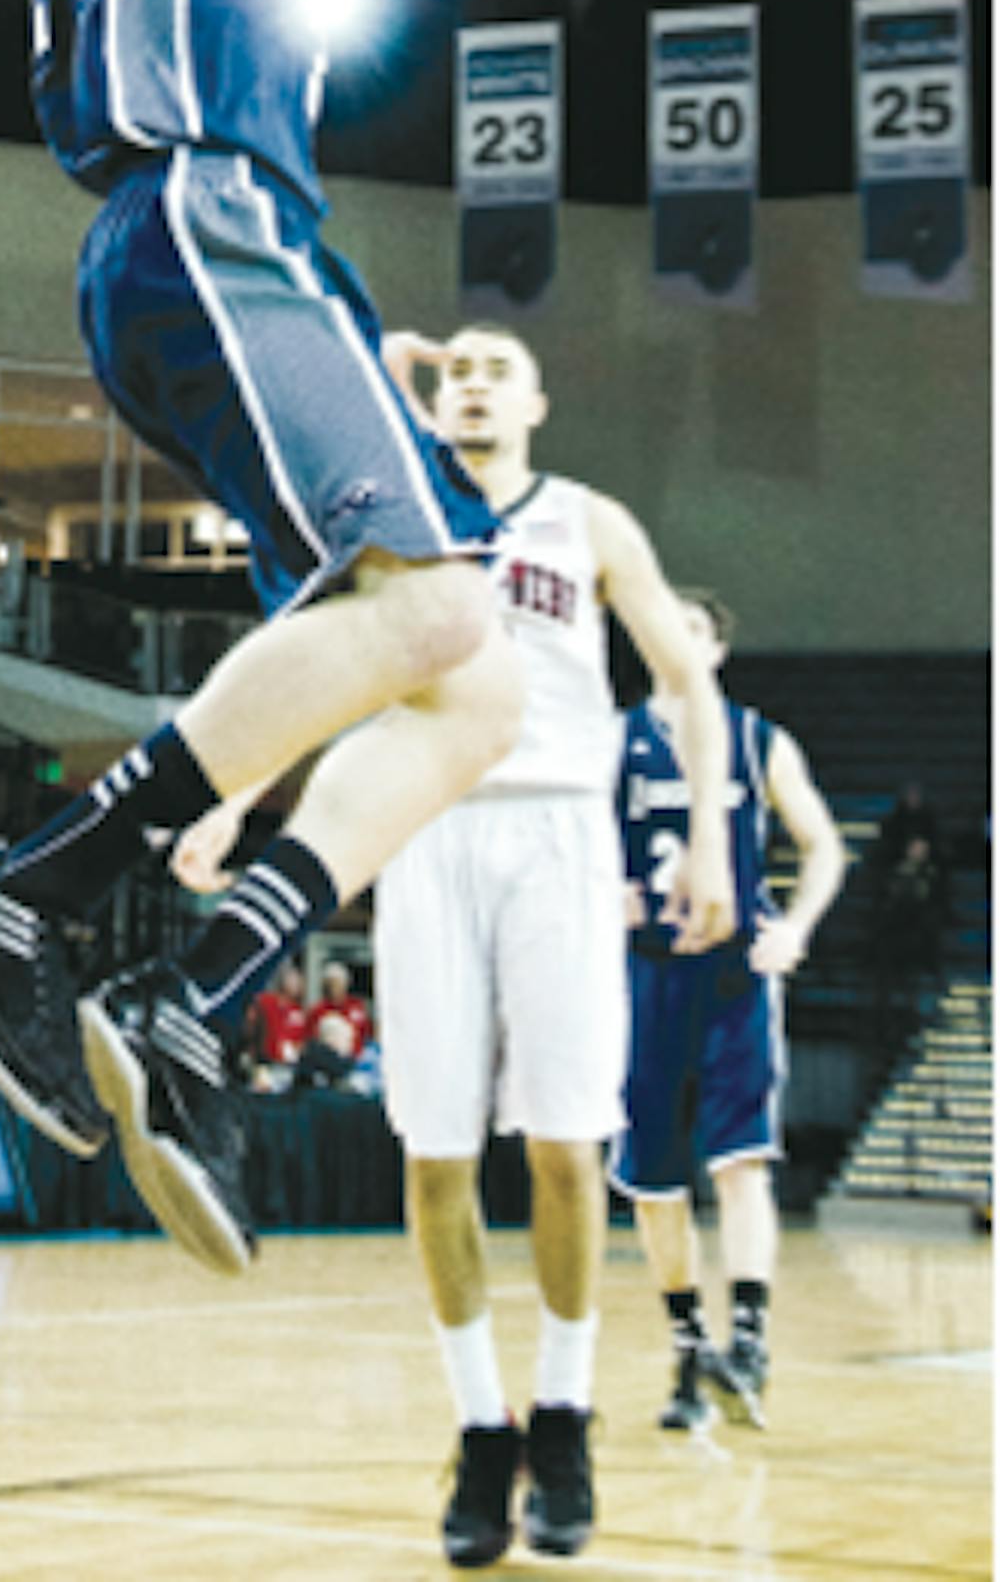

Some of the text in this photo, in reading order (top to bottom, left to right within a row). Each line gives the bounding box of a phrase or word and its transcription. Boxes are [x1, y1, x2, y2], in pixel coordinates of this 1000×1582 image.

[665, 97, 745, 152] 50
[871, 83, 955, 139] 25
[471, 113, 548, 165] 23
